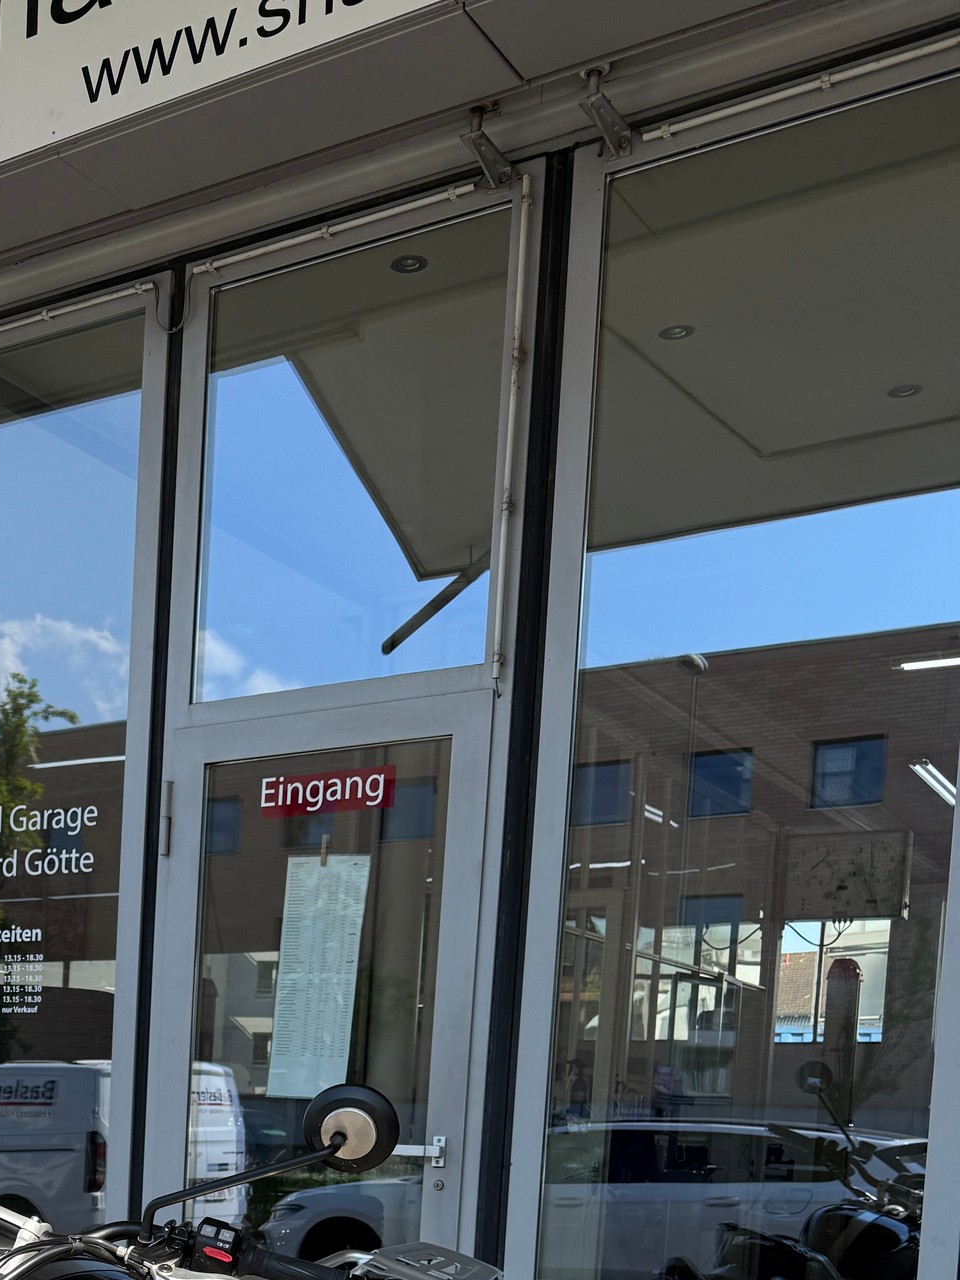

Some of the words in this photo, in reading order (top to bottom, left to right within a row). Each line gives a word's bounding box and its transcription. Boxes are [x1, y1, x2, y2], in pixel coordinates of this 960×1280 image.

[260, 772, 385, 812] Eingang
[9, 804, 98, 836] Garage
[24, 847, 94, 876] Götte
[4, 954, 21, 962] 13.15
[26, 964, 43, 972] 18.30
